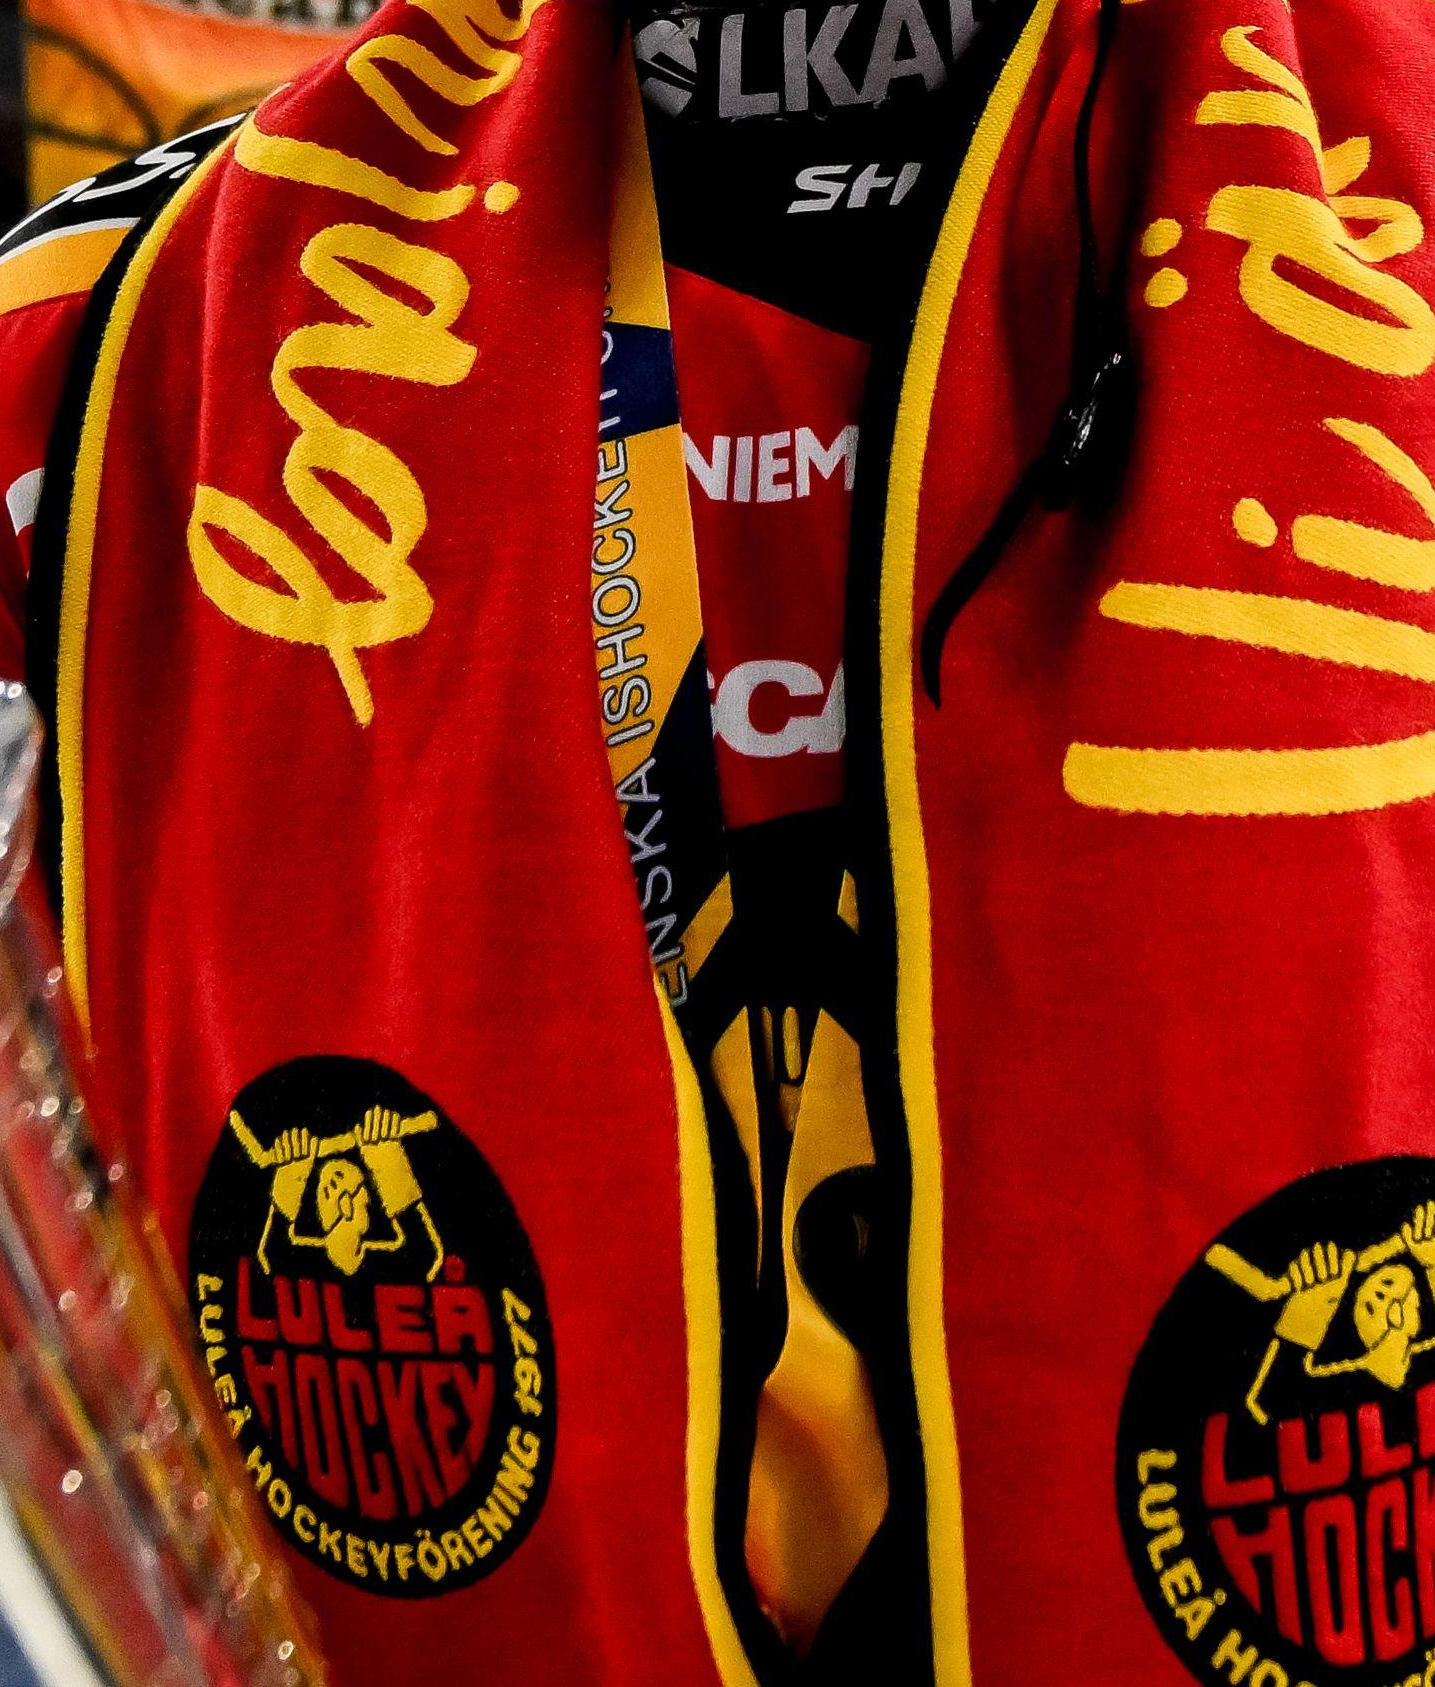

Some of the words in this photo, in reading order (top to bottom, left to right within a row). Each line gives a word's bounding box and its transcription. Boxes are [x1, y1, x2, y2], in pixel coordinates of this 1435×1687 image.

[236, 1255, 495, 1355] LULEÅ
[197, 1273, 252, 1439] LULEÅ
[246, 1424, 541, 1583] HOCKEYFÖRENING
[502, 1286, 544, 1418] 1977
[241, 1345, 496, 1521] HOCKEY
[1137, 1449, 1227, 1642] LULEÅ
